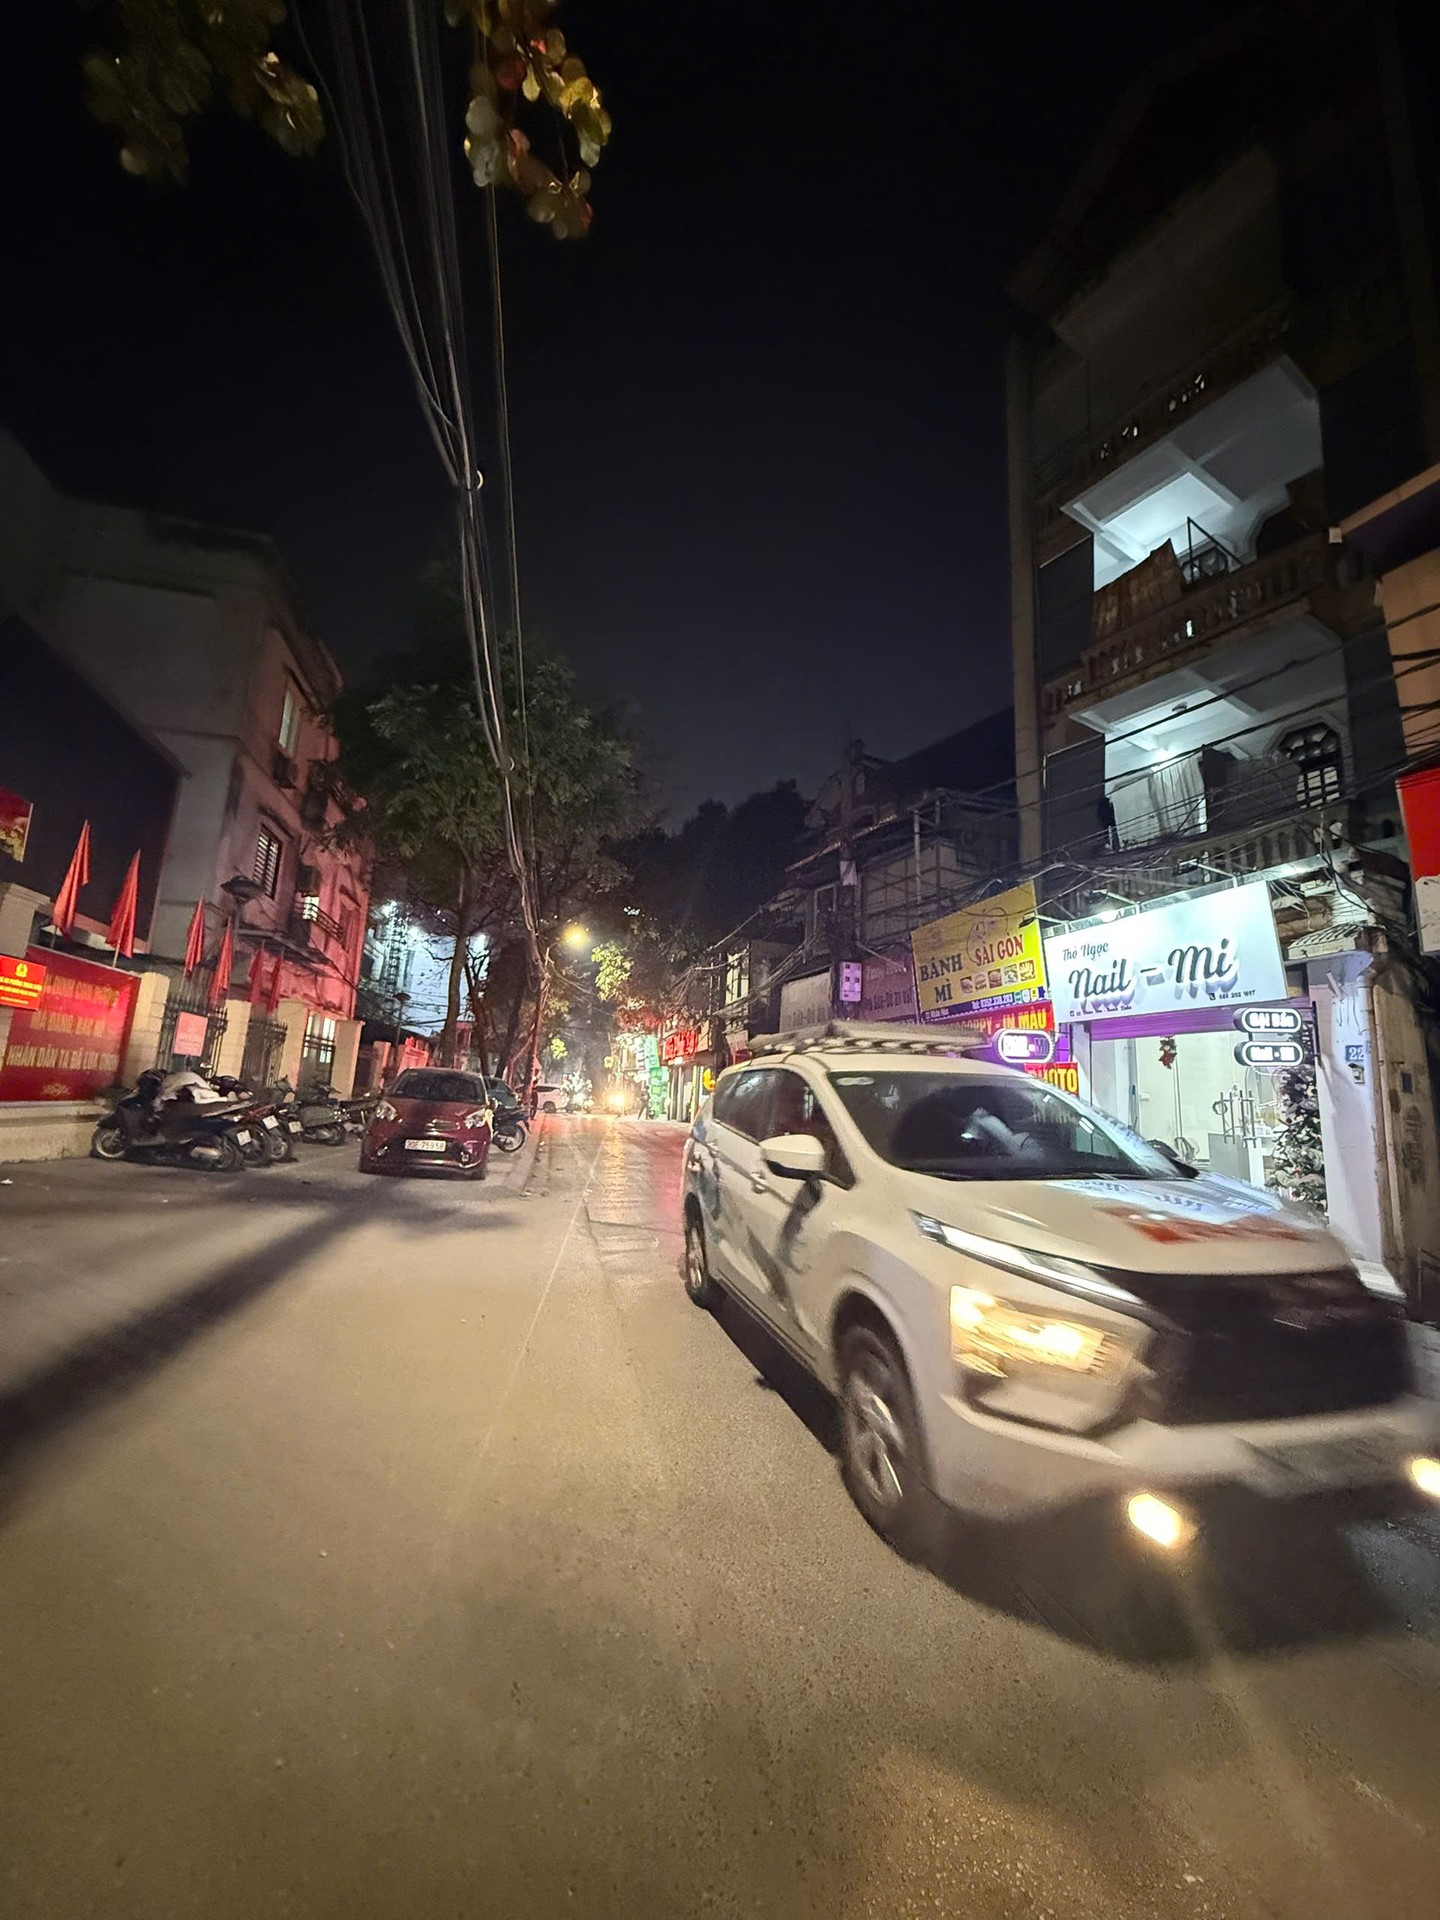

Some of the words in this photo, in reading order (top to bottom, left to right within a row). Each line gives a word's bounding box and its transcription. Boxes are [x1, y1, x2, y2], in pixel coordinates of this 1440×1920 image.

[975, 941, 995, 966] SÀI
[997, 933, 1024, 961] GÒN
[919, 953, 963, 982] BÁNH
[1068, 958, 1131, 999] Nail
[1168, 938, 1233, 984] Mi
[934, 978, 953, 1003] MÌ
